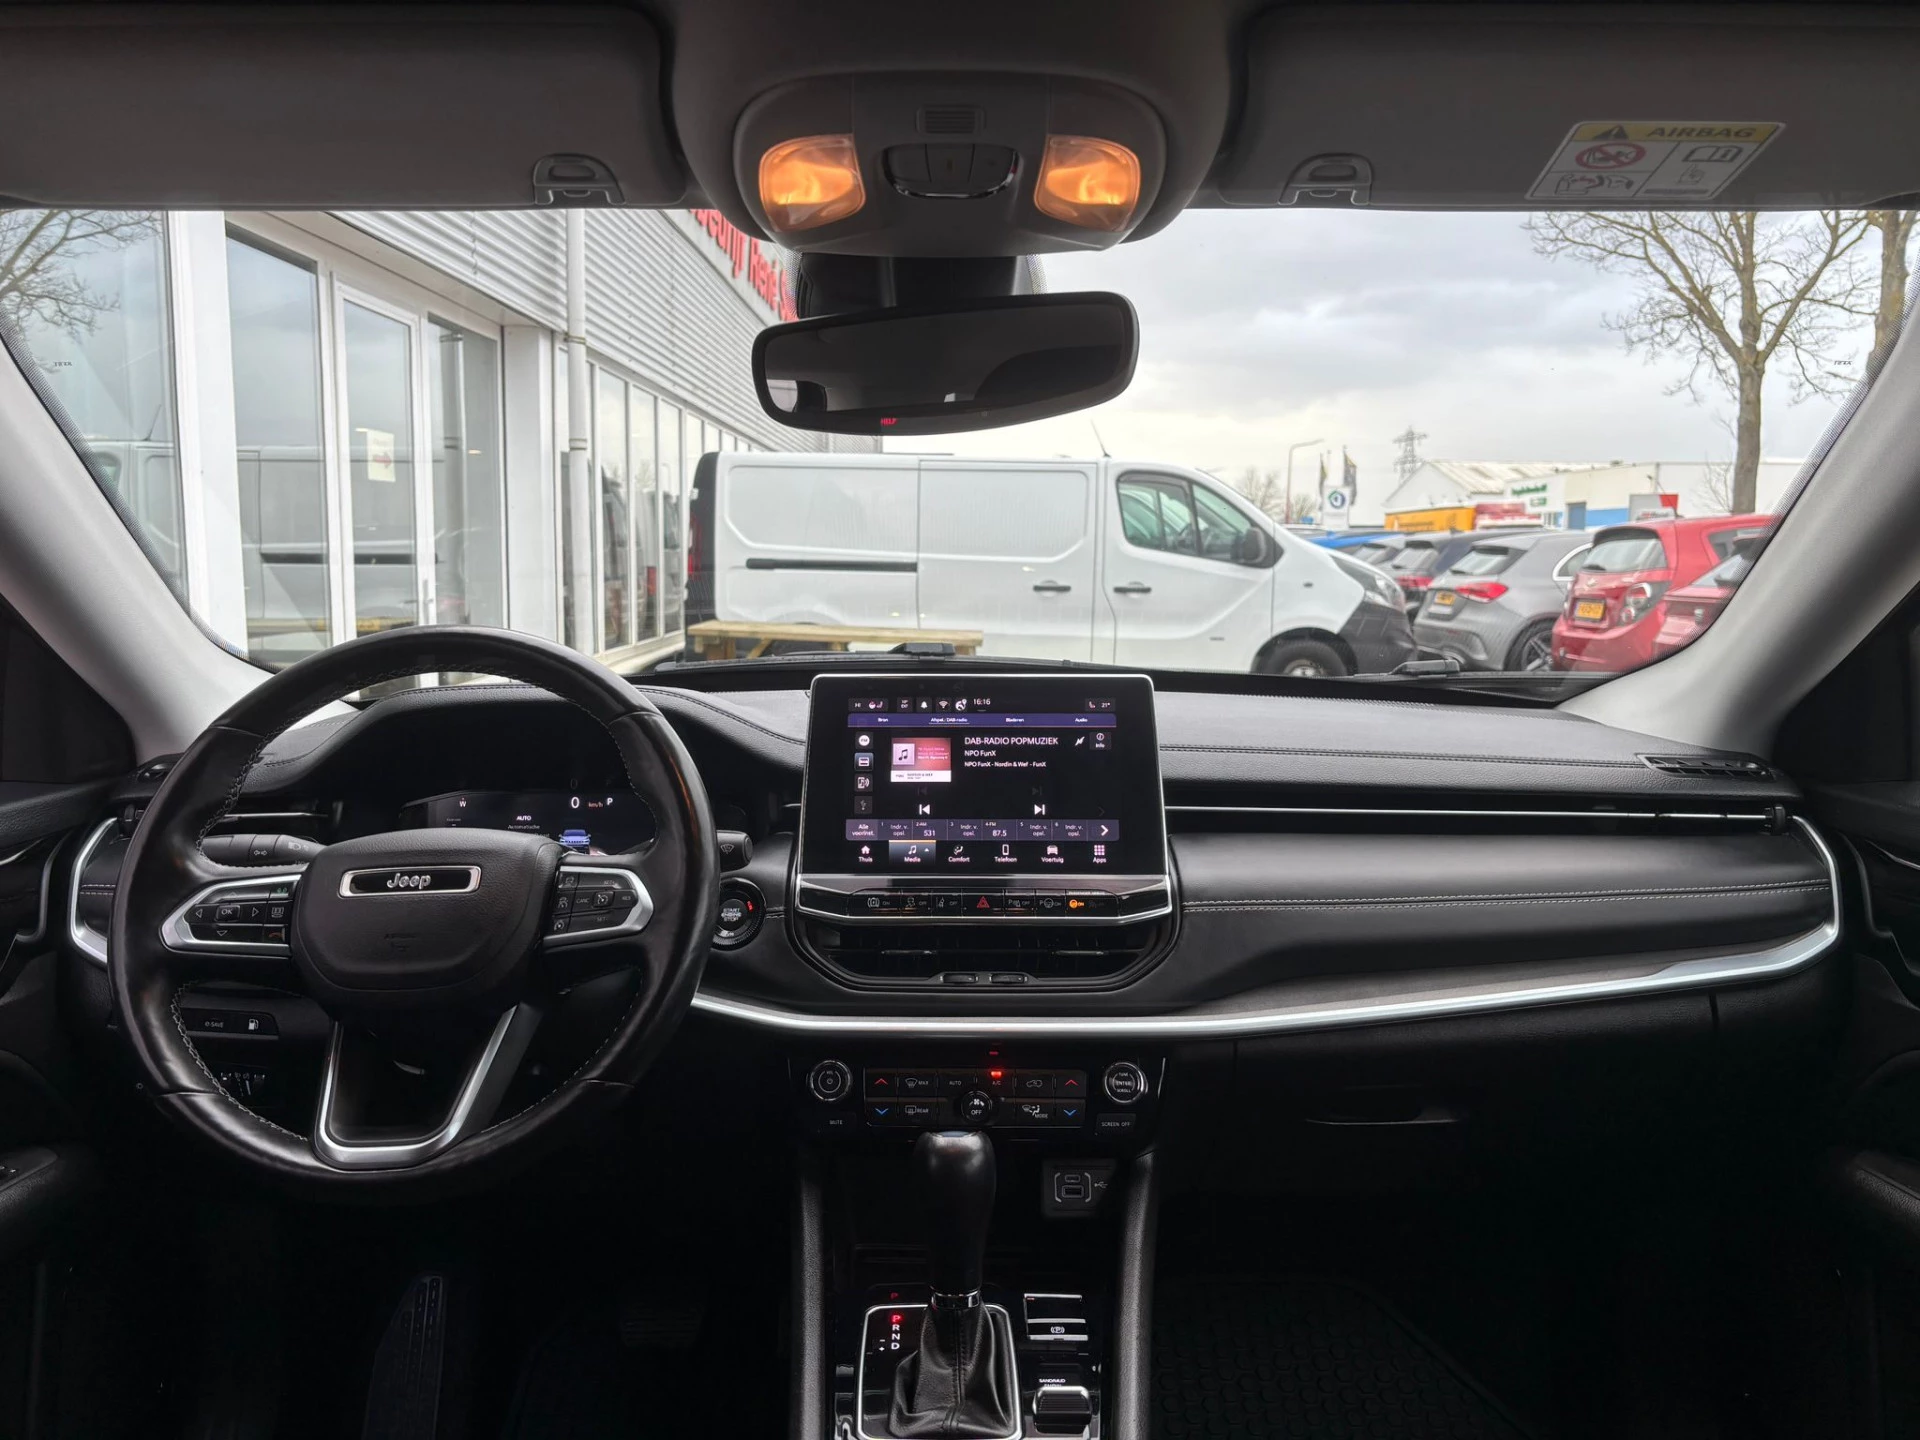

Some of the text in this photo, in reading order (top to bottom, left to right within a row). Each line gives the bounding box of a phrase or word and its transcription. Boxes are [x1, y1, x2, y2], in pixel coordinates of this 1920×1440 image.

[1647, 127, 1756, 138] AIRBAG
[973, 698, 991, 706] 16:16
[964, 736, 1059, 745] DAB-RADIO POPMUZIEK
[571, 796, 580, 809] 0
[606, 797, 613, 806] P
[923, 829, 936, 837] 531
[992, 829, 1007, 837] 87.5
[1040, 856, 1064, 864] Voertuig
[1092, 856, 1107, 864] Apps
[386, 873, 432, 890] Jeep
[221, 907, 233, 915] OK
[970, 1108, 982, 1116] OFF
[892, 1323, 901, 1331] R
[891, 1333, 901, 1341] N
[890, 1342, 900, 1350] D
